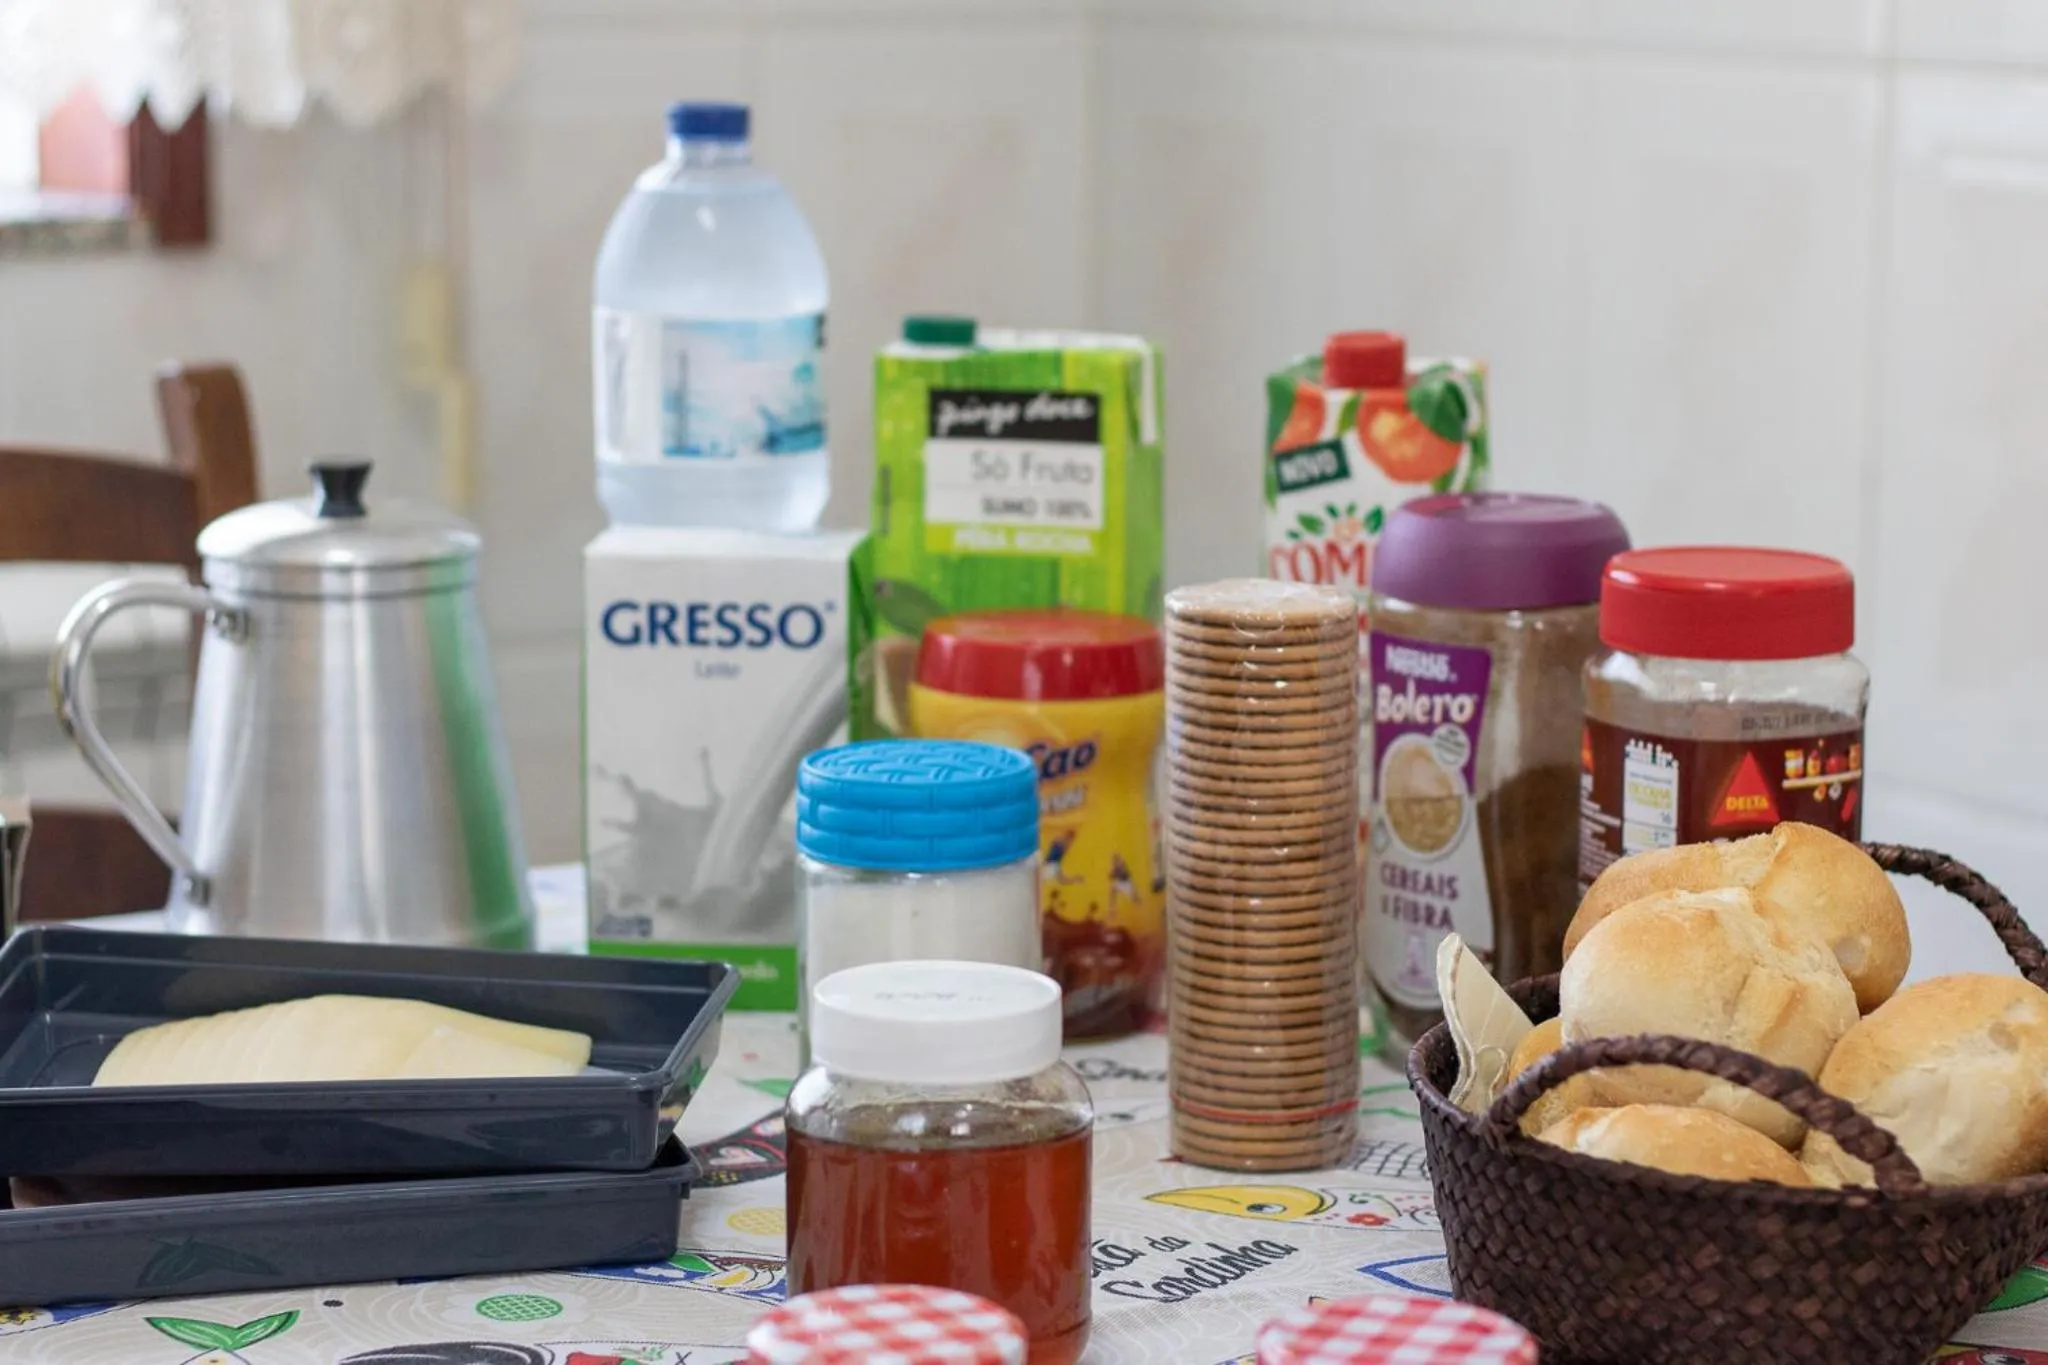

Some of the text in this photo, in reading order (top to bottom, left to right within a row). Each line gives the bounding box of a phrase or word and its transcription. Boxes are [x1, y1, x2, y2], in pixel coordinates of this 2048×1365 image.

[1279, 447, 1340, 487] NOVO
[1268, 539, 1368, 588] COM
[600, 599, 825, 650] GRESSO
[1376, 676, 1475, 724] Bolero
[1724, 795, 1771, 812] DELTA
[1380, 859, 1460, 900] CEREAIS
